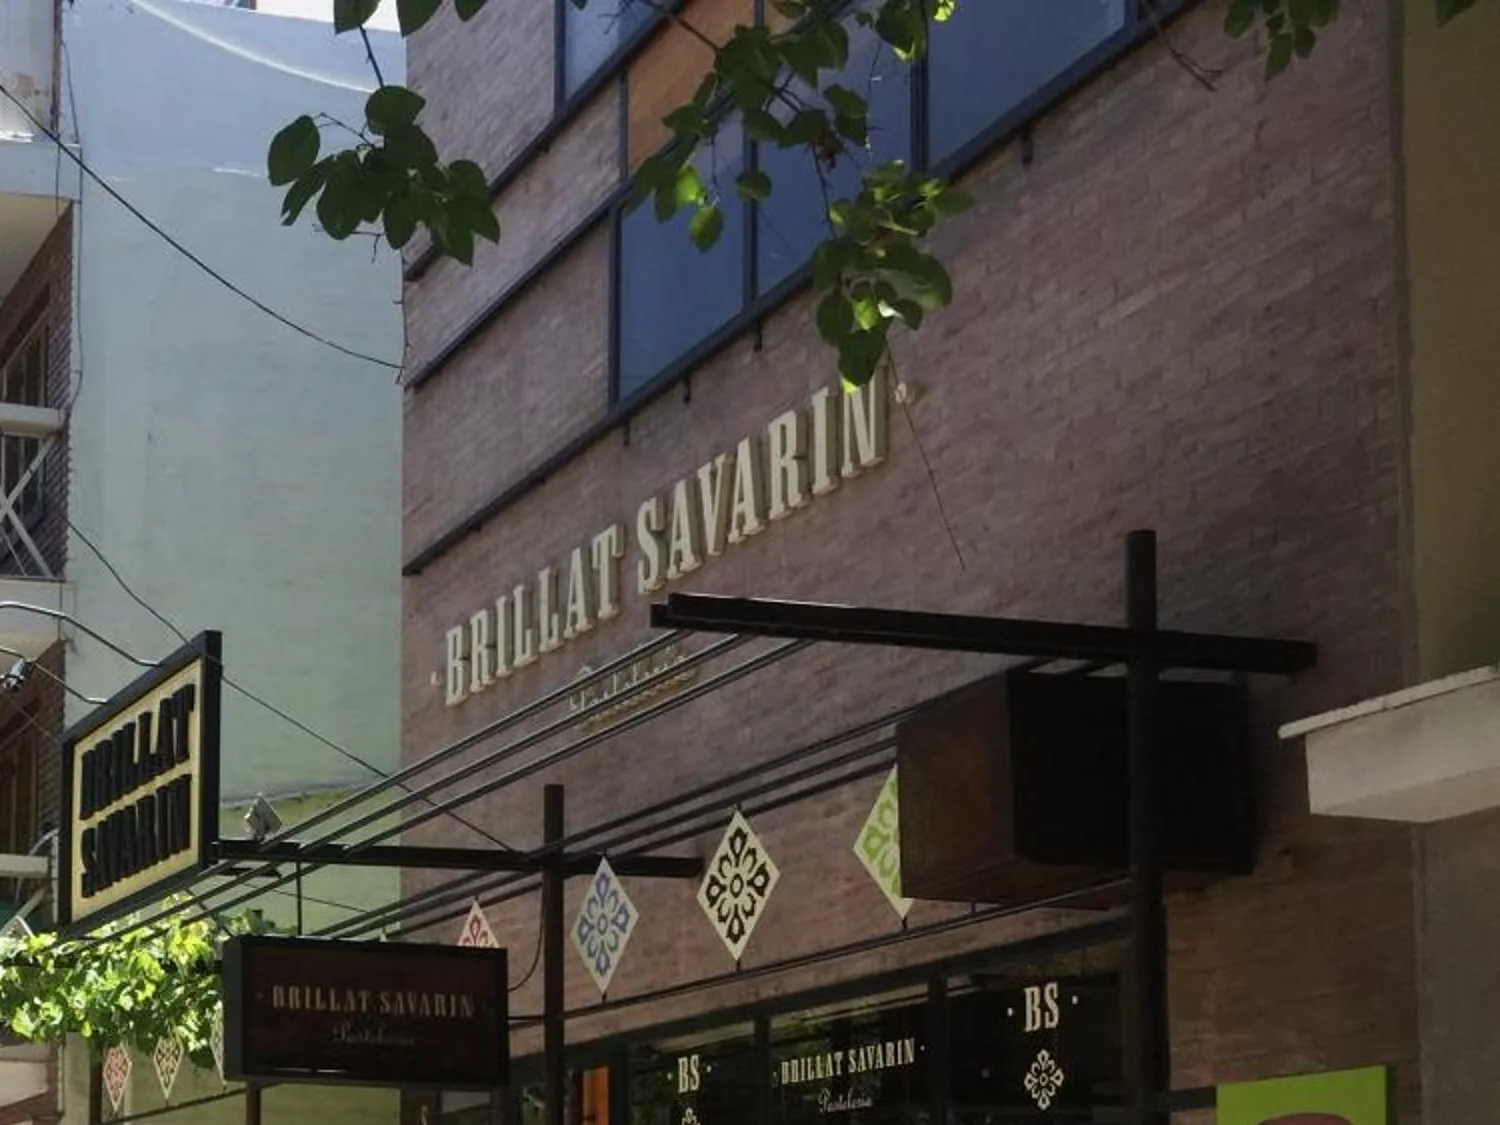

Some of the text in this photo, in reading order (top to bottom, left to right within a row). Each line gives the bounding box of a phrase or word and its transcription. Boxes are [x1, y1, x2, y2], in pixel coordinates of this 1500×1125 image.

[445, 345, 890, 708] BRILLAT SAVARIN
[272, 984, 475, 1018] BRILLAT SAVARIN
[1024, 982, 1060, 1033] BS
[677, 1054, 701, 1094] BS
[780, 1036, 916, 1086] BRILLAT SAVARIN
